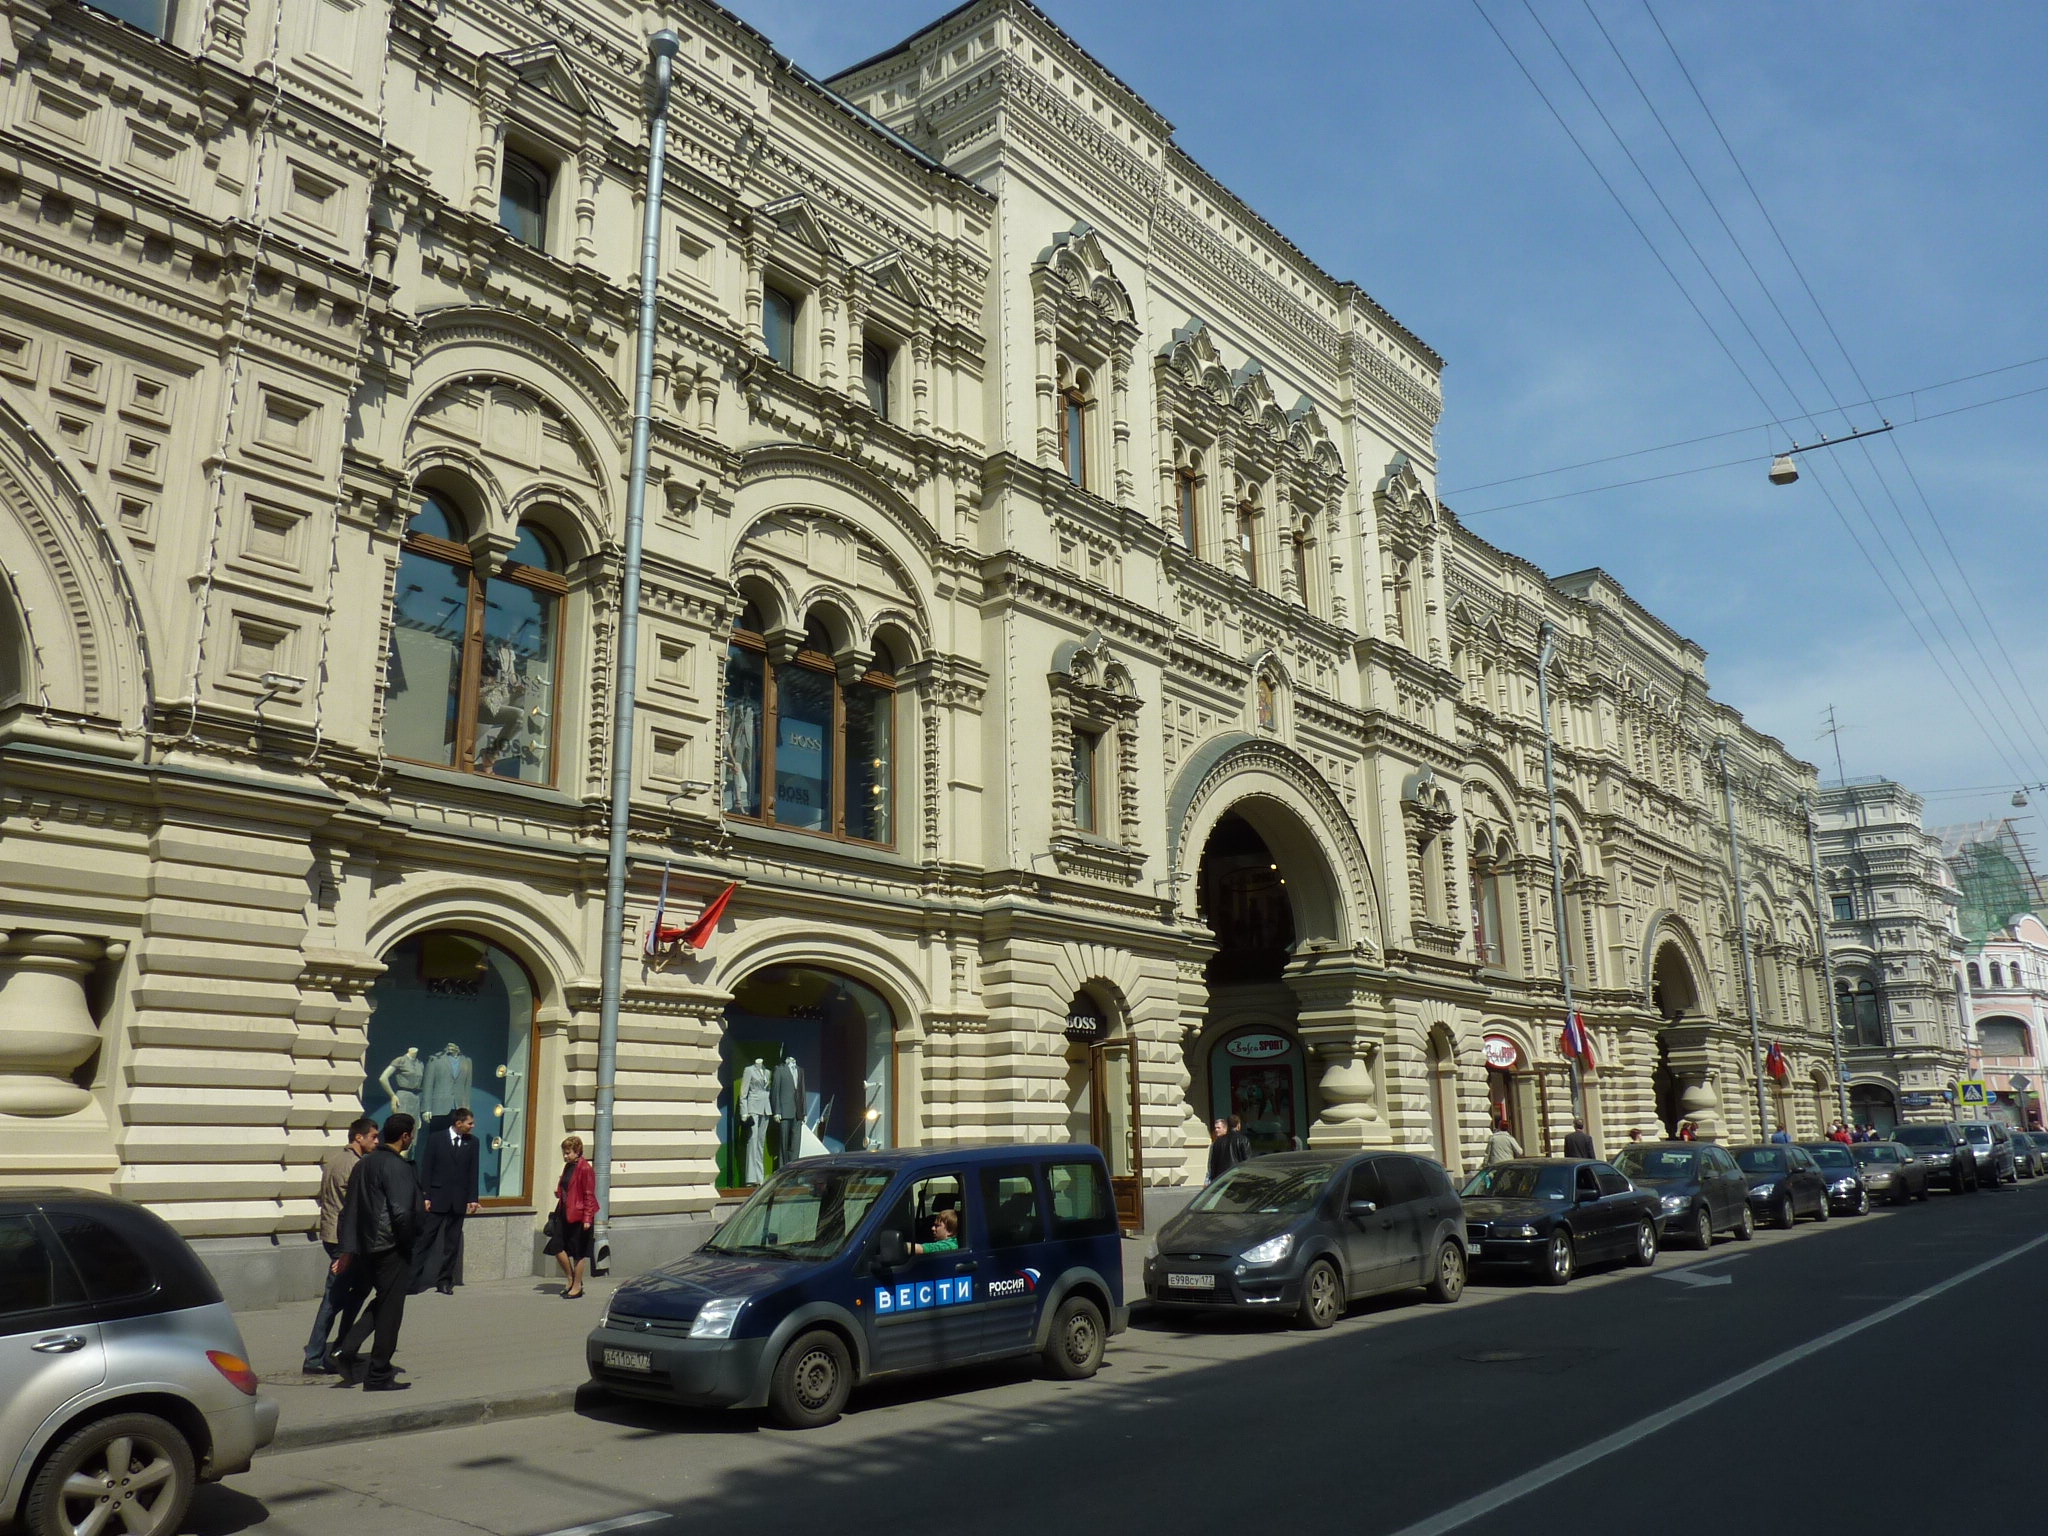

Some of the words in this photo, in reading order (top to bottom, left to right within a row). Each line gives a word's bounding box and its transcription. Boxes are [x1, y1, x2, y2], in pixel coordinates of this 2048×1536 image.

[790, 732, 822, 751] BOSS
[1066, 1015, 1097, 1030] BOSS
[989, 1278, 1024, 1292] РОССИЯ
[879, 1281, 969, 1309] ВЕСТИ
